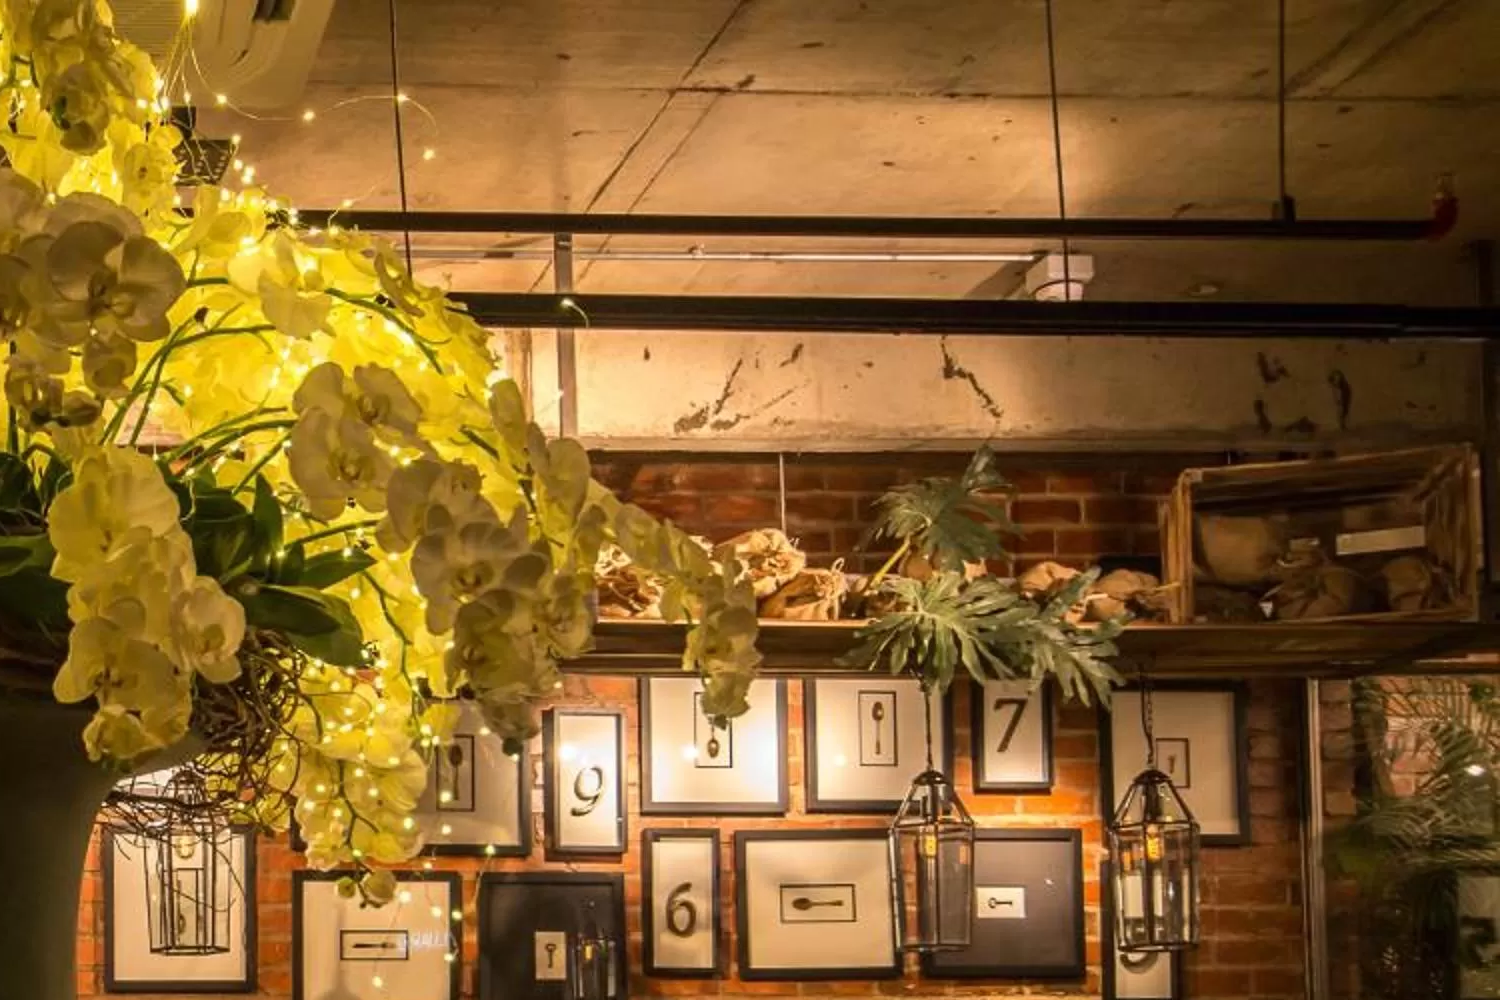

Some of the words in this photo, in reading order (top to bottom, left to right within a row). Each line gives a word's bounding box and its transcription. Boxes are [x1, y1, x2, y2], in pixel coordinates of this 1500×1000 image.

[991, 697, 1026, 753] 7
[570, 764, 605, 817] 9
[665, 881, 697, 938] 6
